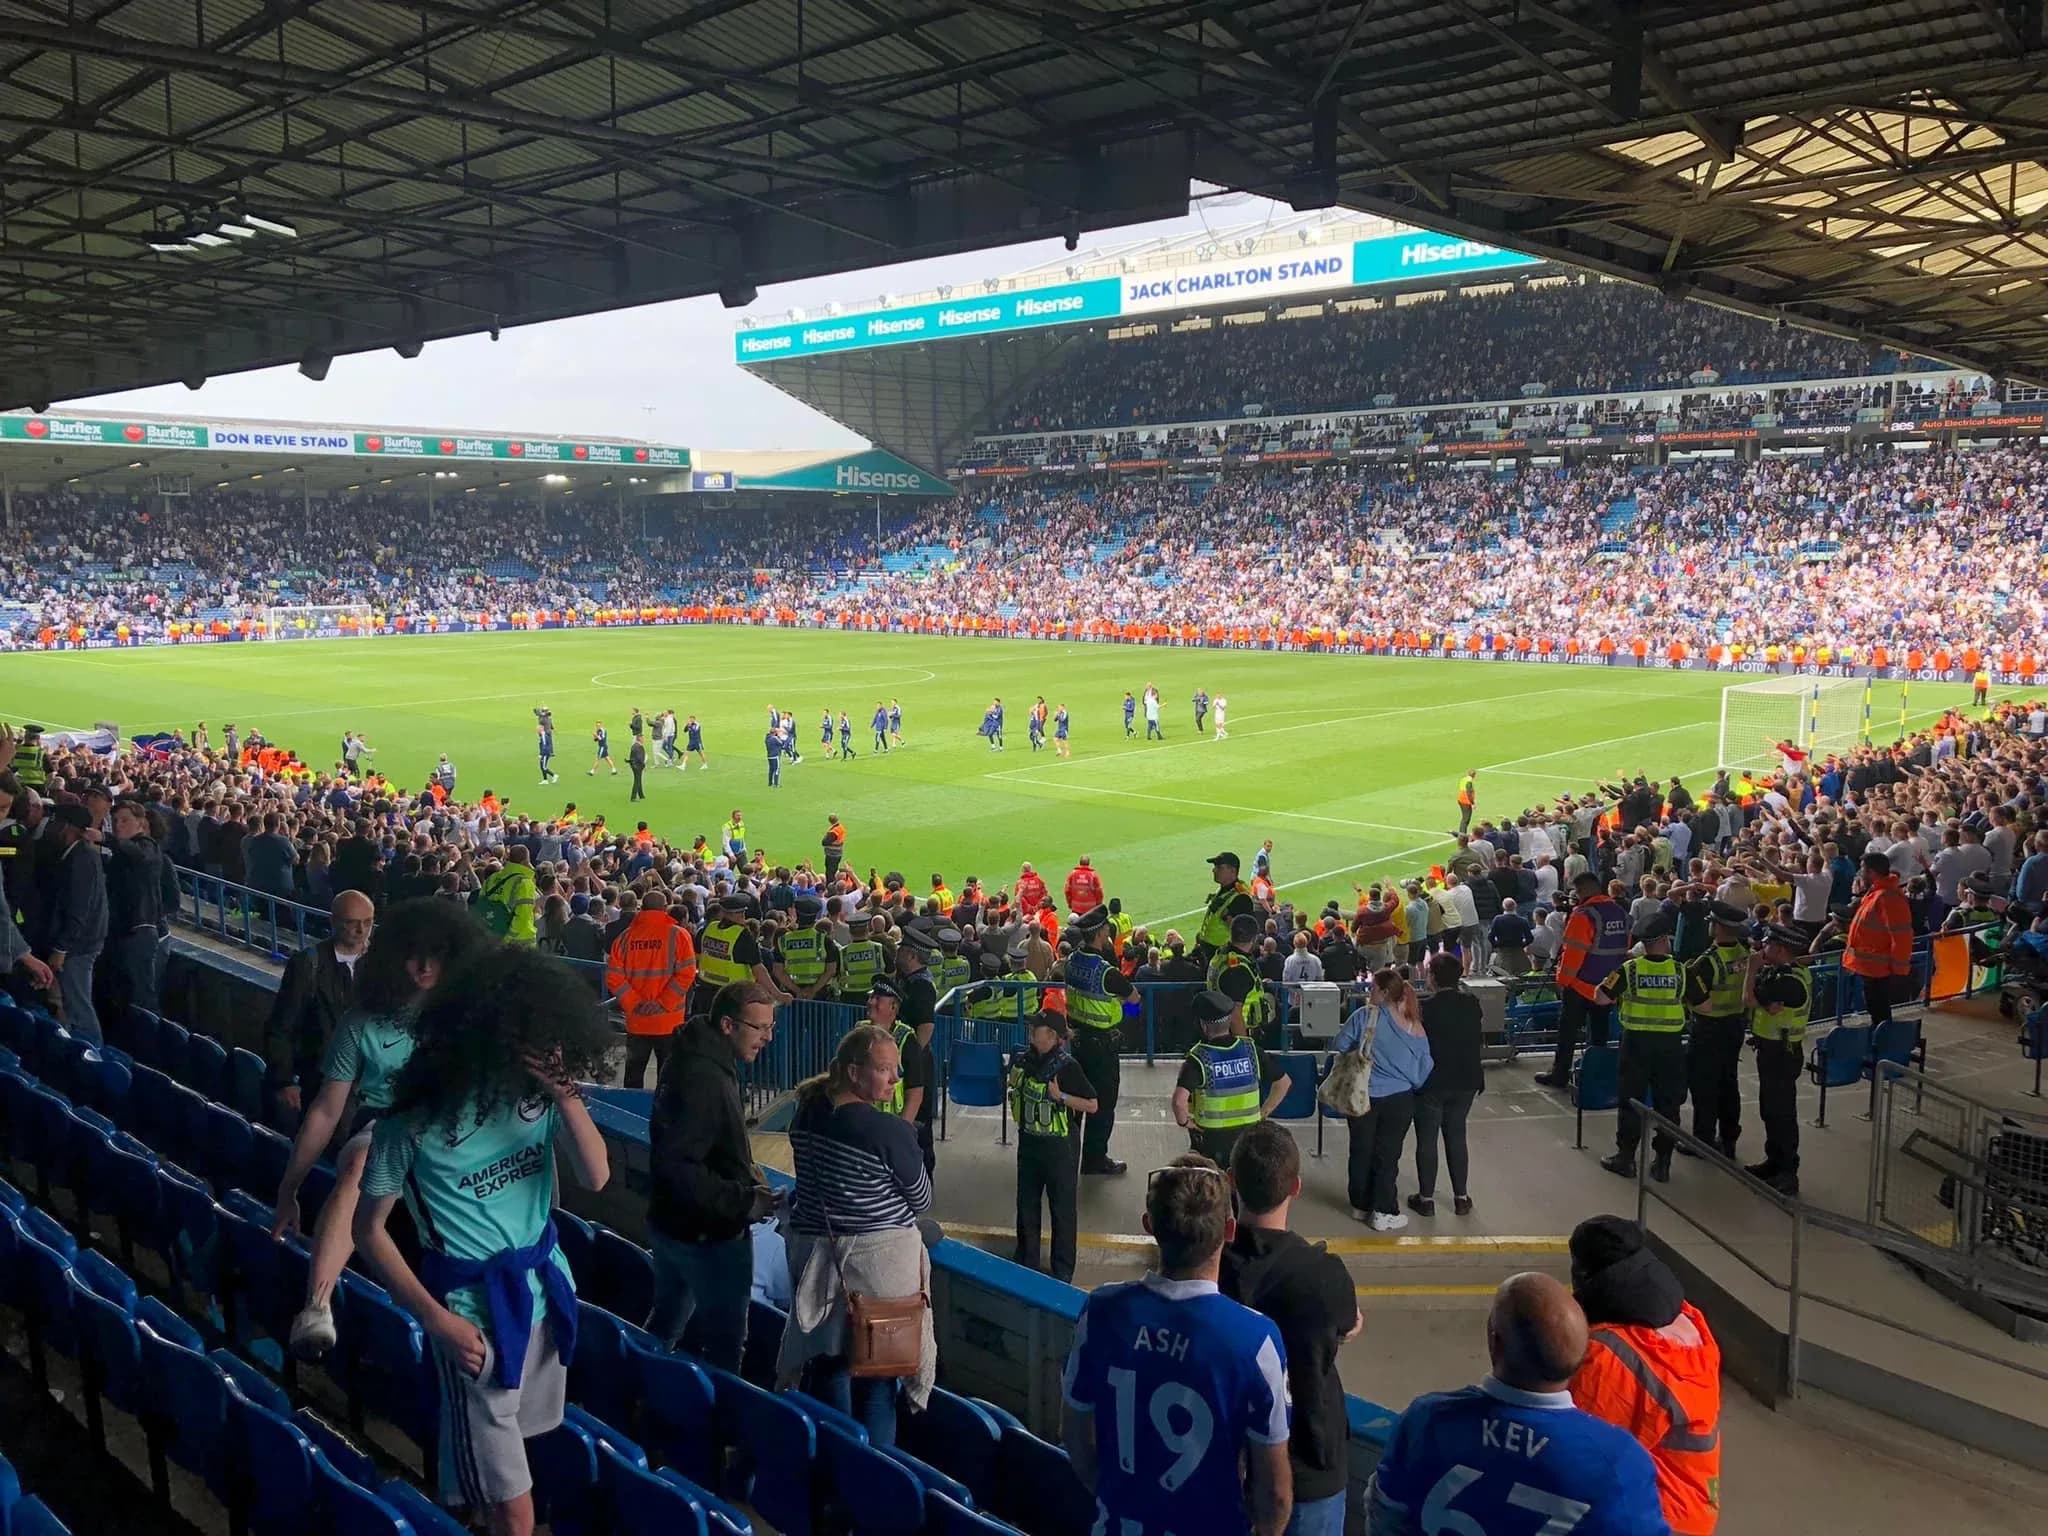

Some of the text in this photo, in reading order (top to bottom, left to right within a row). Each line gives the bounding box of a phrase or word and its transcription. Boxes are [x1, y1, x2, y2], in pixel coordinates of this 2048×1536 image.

[1129, 256, 1343, 301] JACK CHARLTON STAND
[1015, 295, 1084, 317] Hisense
[938, 306, 1001, 327] Hisense
[867, 317, 925, 336] Hisense
[802, 325, 856, 345] Hisense
[742, 335, 792, 353] Hisense
[49, 420, 102, 434] Burflex
[1783, 424, 1851, 434] www.aes.group
[1891, 422, 1914, 431] aes
[1922, 415, 2043, 429] Auto Electrical Supplies Ltd
[147, 425, 195, 439] Burflex
[1635, 434, 1654, 443] aes
[215, 432, 348, 448] DON REVIE STAND
[384, 437, 423, 448] Burflex
[457, 439, 493, 450] Burflex
[524, 442, 560, 453] Burflex
[1547, 437, 1602, 446] www.aes.group
[588, 445, 621, 456] Burflex
[648, 448, 680, 460] Burflex
[836, 465, 920, 488] Hisense
[630, 939, 662, 951] STEWARD
[703, 937, 729, 952] POLICE
[787, 939, 812, 950] POLICE
[848, 951, 873, 962] POLICE
[1299, 966, 1309, 982] 4
[1639, 976, 1673, 988] POLICE
[1214, 1060, 1249, 1077] POLICE
[457, 1142, 545, 1190] AMERICAN
[473, 1159, 545, 1199] EXPRES
[1133, 1326, 1190, 1361] ASH
[1107, 1366, 1214, 1493] 19
[1482, 1418, 1549, 1459] KEV
[1420, 1463, 1592, 1536] 67
